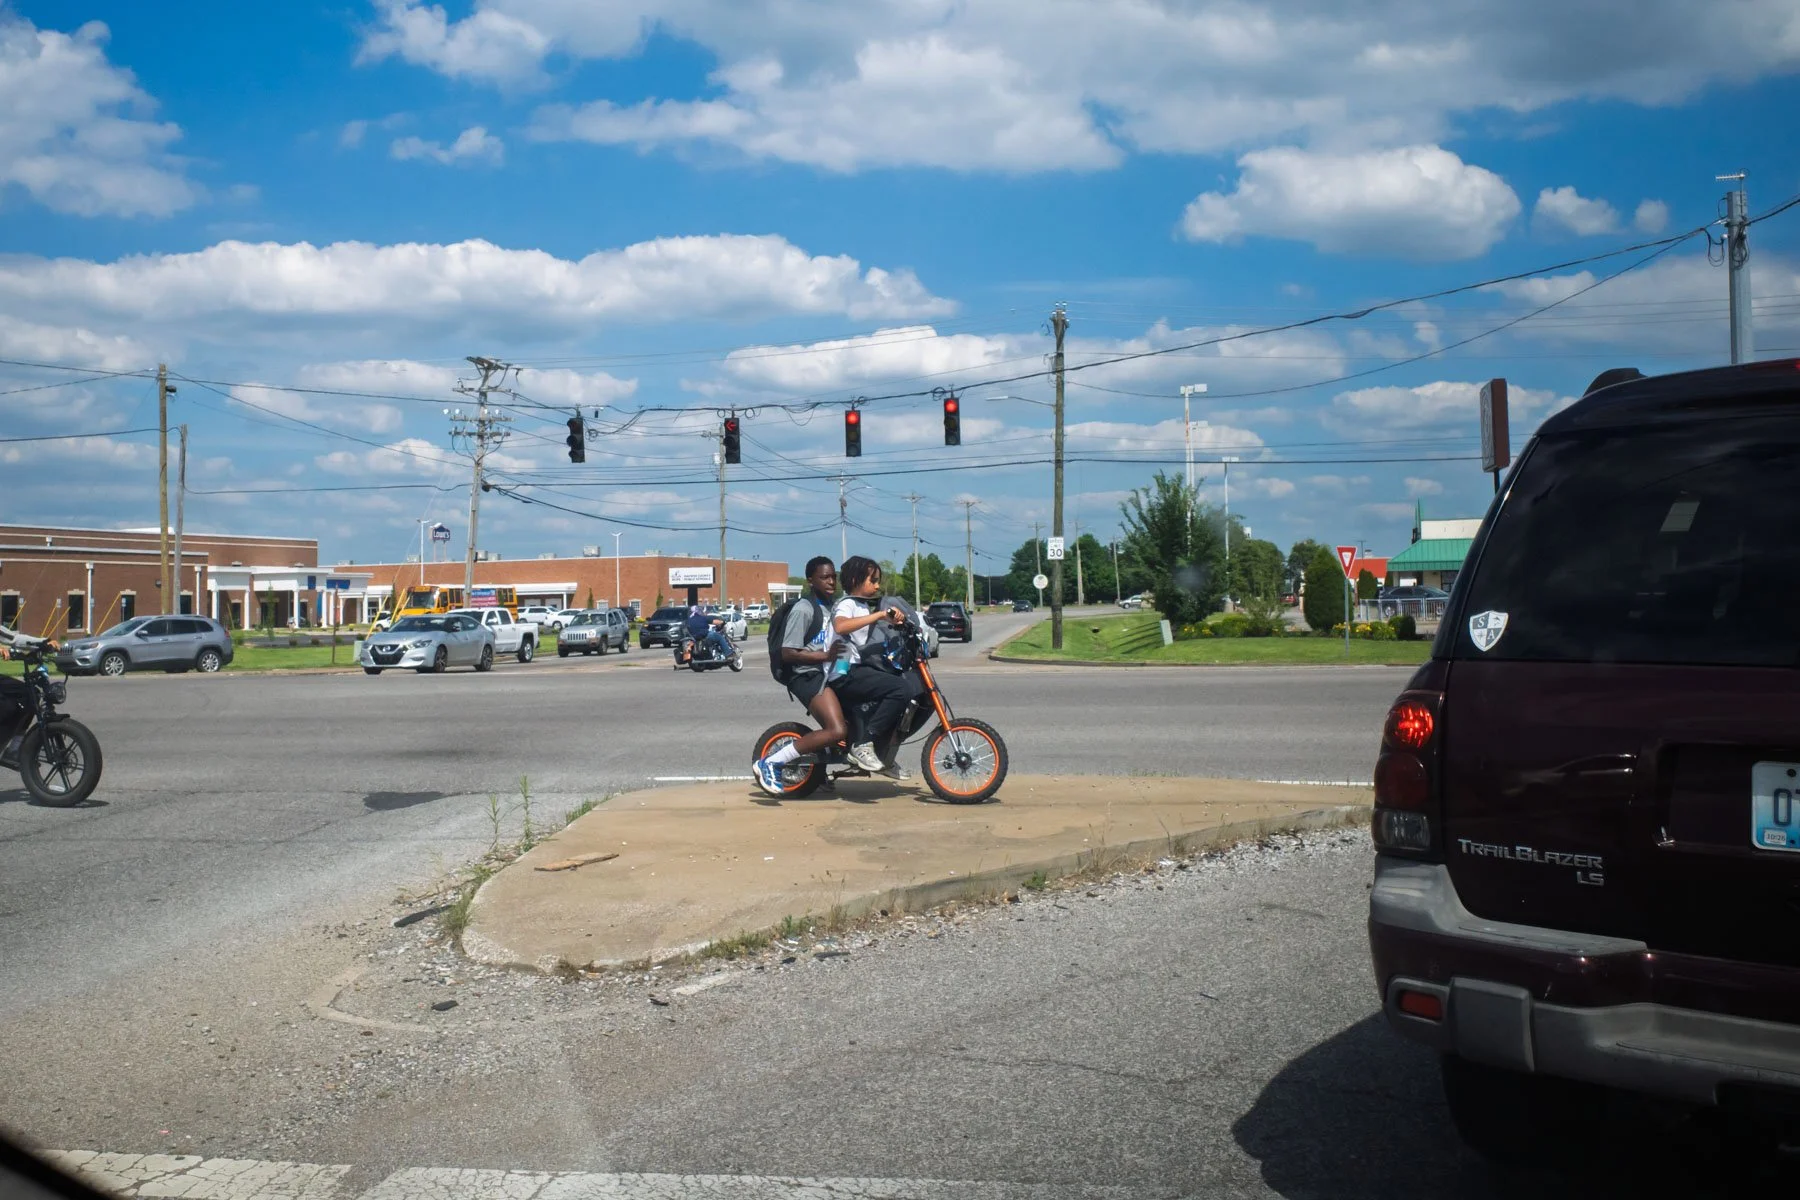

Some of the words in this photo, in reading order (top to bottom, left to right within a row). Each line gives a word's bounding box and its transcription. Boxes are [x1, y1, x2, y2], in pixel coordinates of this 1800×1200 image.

[1049, 548, 1063, 557] 30
[1477, 616, 1486, 628] S
[1486, 628, 1496, 640] A
[1576, 871, 1604, 886] LS
